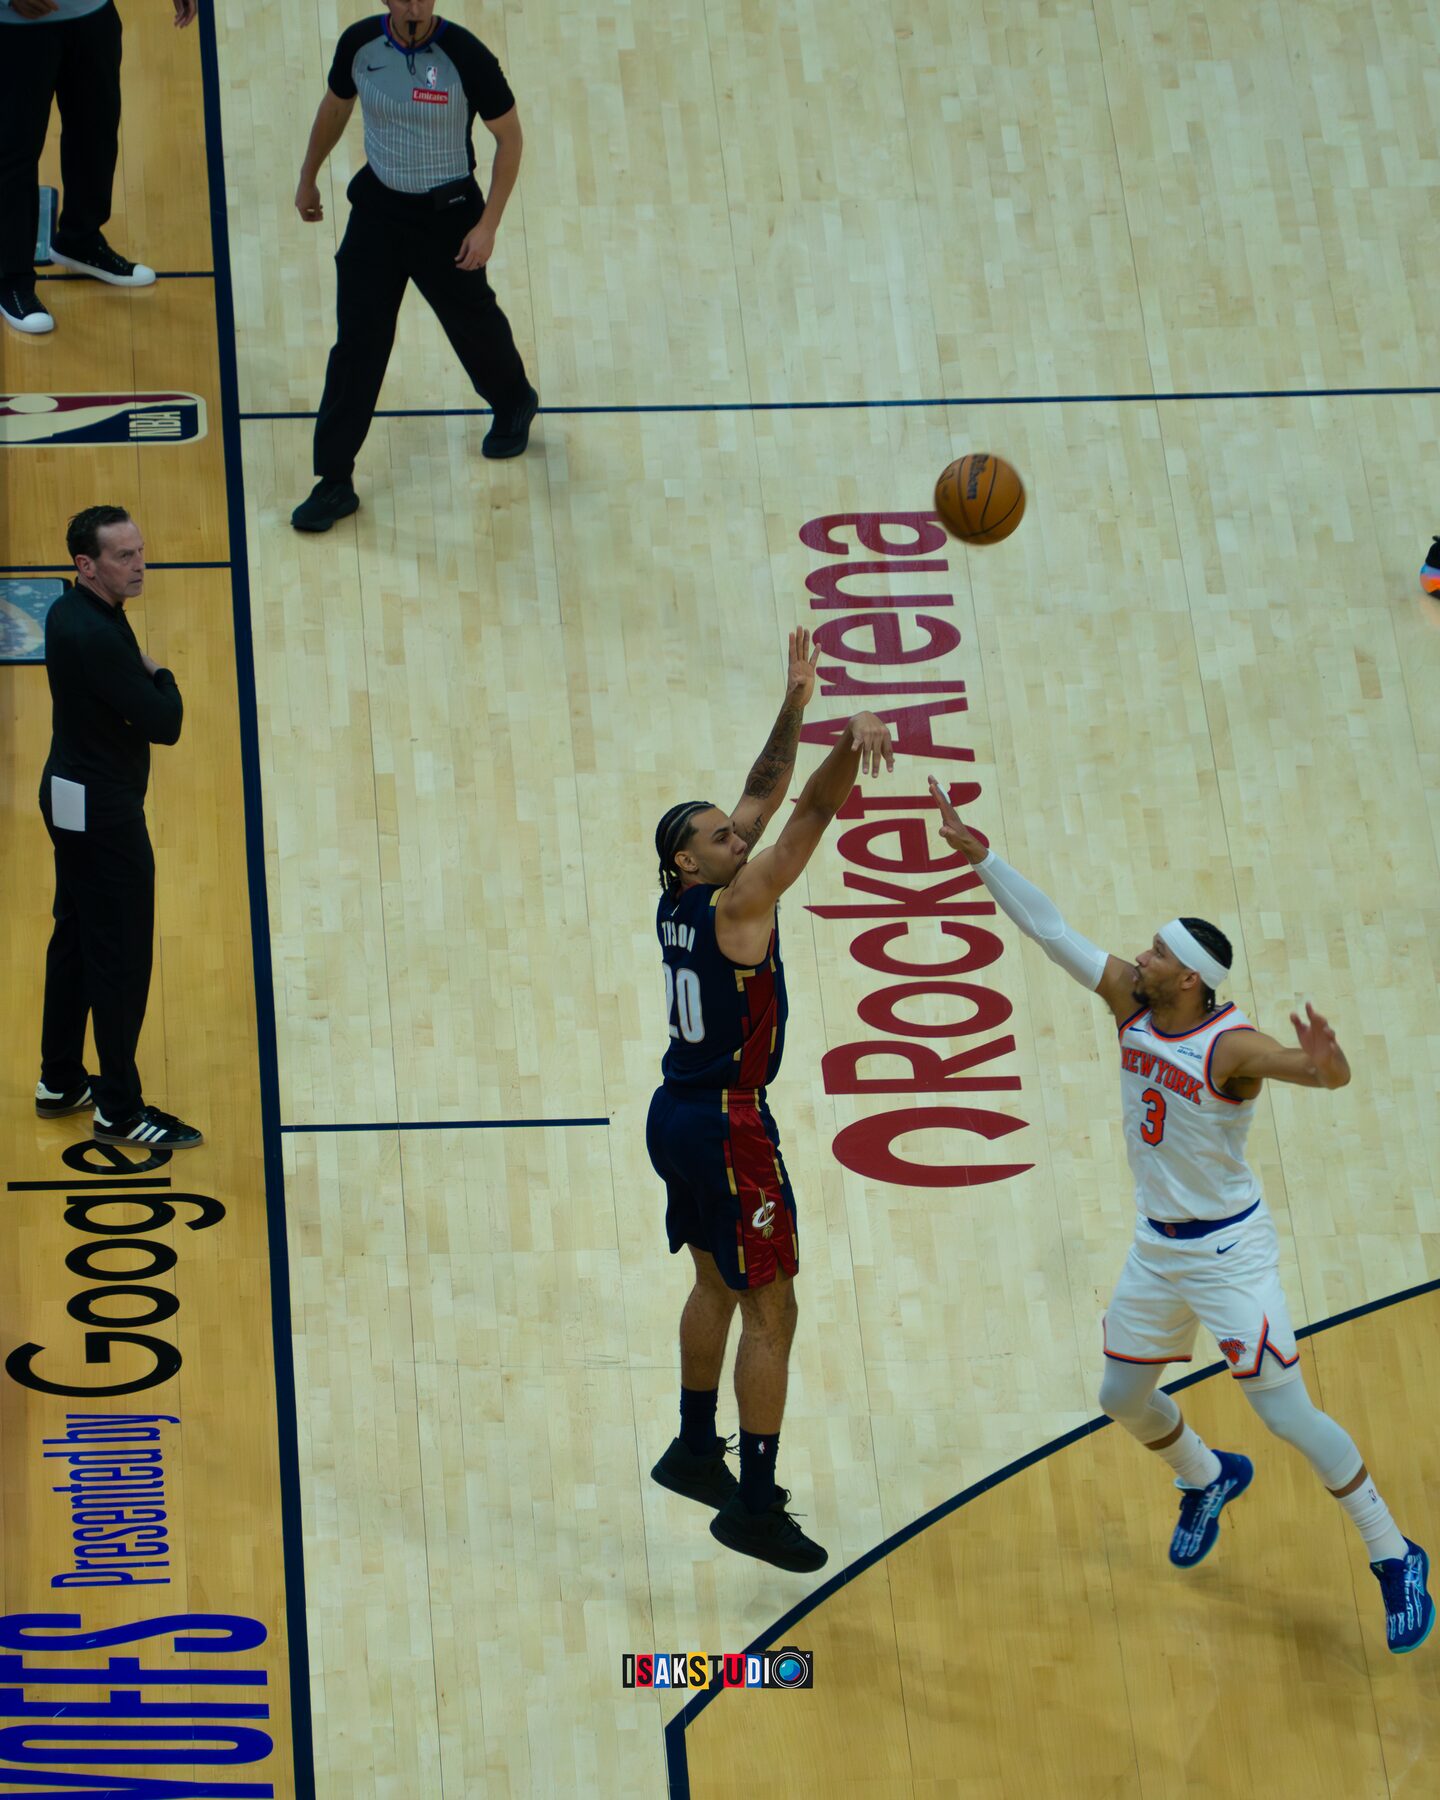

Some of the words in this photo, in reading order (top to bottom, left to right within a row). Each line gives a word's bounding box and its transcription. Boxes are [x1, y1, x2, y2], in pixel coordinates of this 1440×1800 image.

[413, 89, 448, 102] Emirates
[128, 411, 182, 438] NBA
[798, 510, 976, 762] Arena
[661, 920, 696, 953] TYSON
[790, 782, 1022, 1095] Rocket
[1121, 1046, 1157, 1079] NEW
[1154, 1057, 1205, 1106] YORK
[1140, 1087, 1167, 1147] 3
[5, 1139, 226, 1398] Google
[42, 1414, 181, 1445] by
[43, 1448, 171, 1588] Presented
